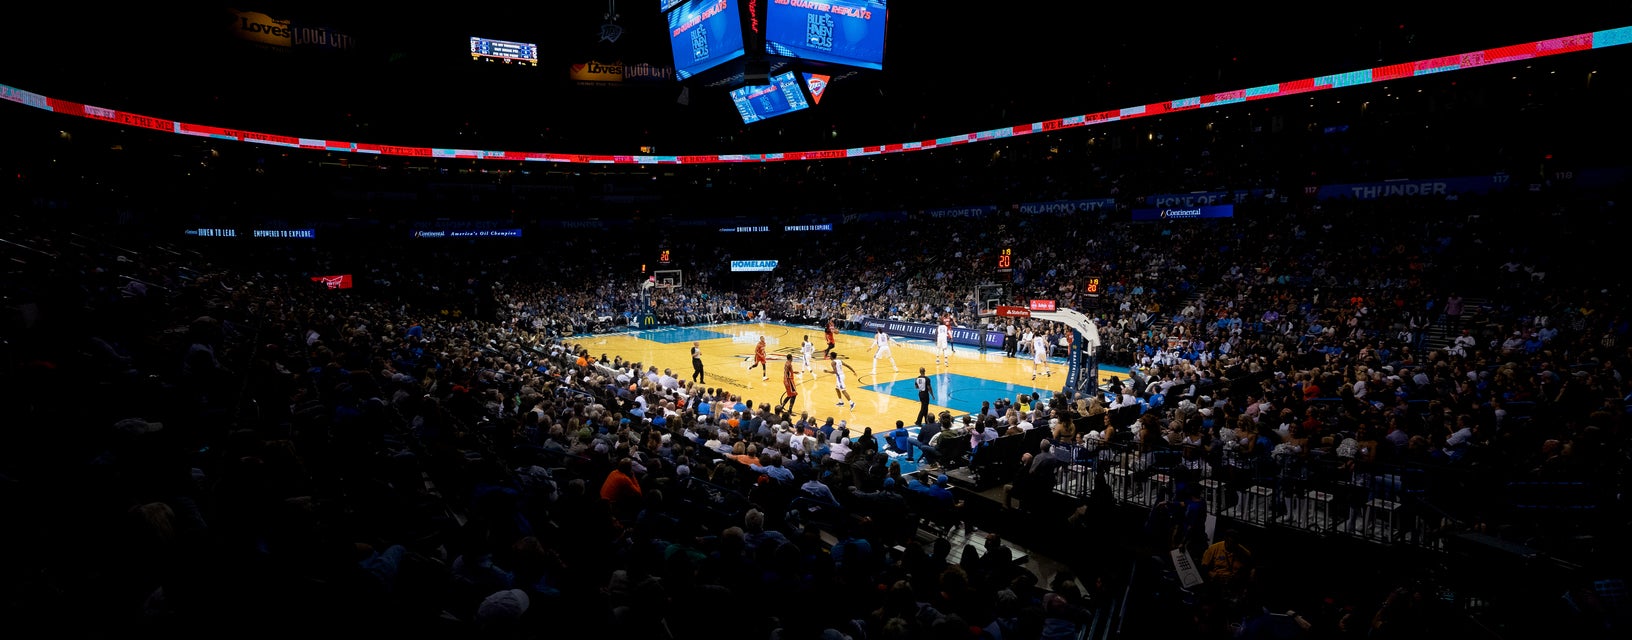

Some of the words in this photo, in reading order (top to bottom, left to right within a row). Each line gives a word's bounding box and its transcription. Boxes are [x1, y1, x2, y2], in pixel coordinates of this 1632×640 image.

[791, 0, 830, 13] QUARTER
[831, 6, 871, 20] REPLAYS
[1351, 181, 1447, 200] THUNDER
[1079, 201, 1105, 211] CITY
[1166, 208, 1201, 216] Continental
[660, 253, 669, 261] 20
[999, 255, 1010, 267] 20
[1087, 284, 1097, 292] 20
[906, 326, 914, 335] TO
[963, 332, 970, 342] TO
